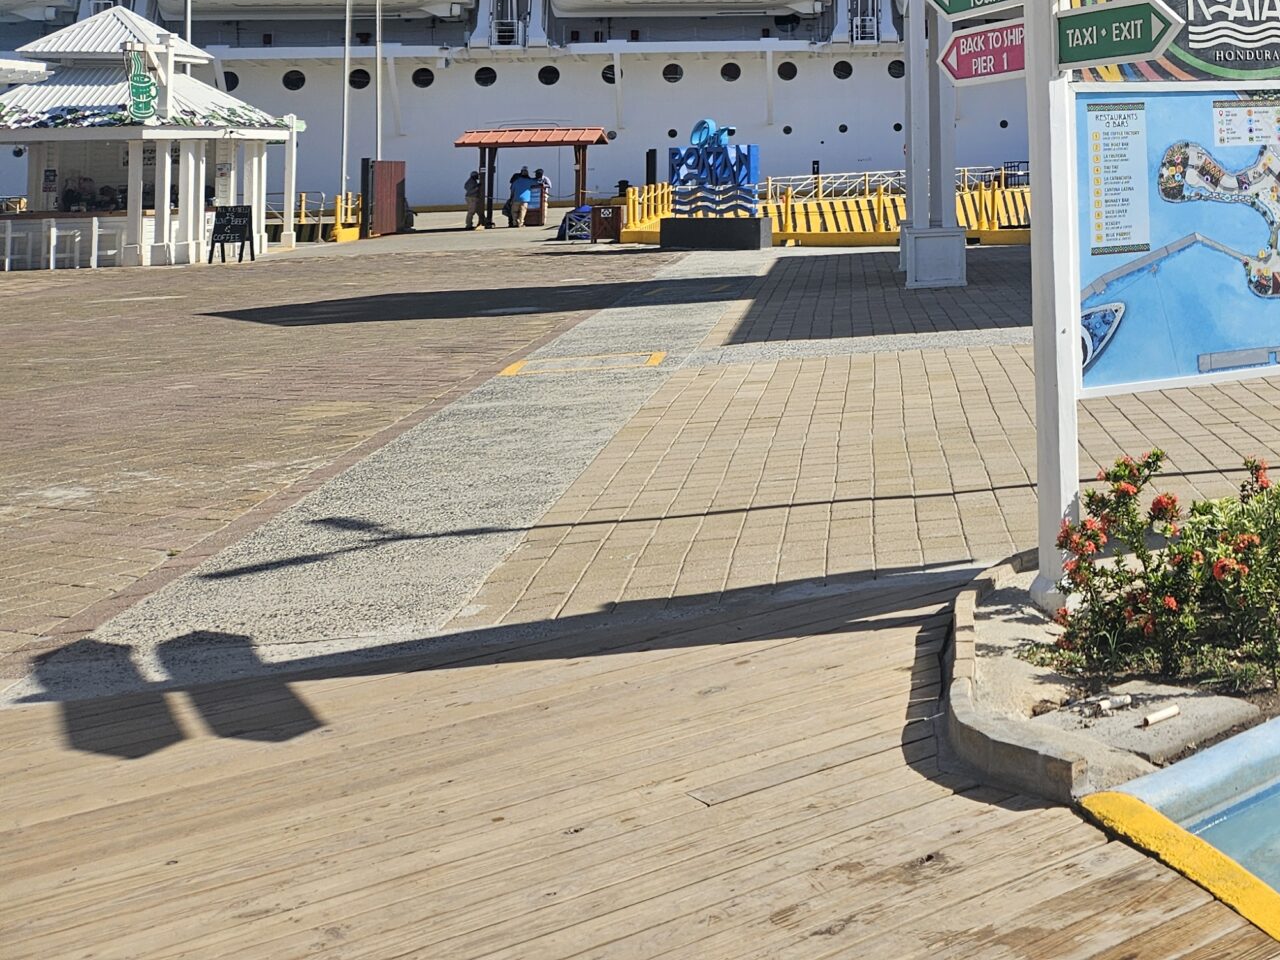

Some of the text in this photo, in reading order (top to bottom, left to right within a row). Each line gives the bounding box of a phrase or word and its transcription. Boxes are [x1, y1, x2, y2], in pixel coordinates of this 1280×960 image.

[959, 27, 1024, 55] BACK TO SHIP
[1066, 20, 1143, 48] TAXI EXIT
[972, 52, 1008, 75] PIER 1
[1096, 113, 1138, 121] RESTAURANTS
[668, 145, 752, 186] ROATAN
[213, 233, 241, 241] COFFEE
